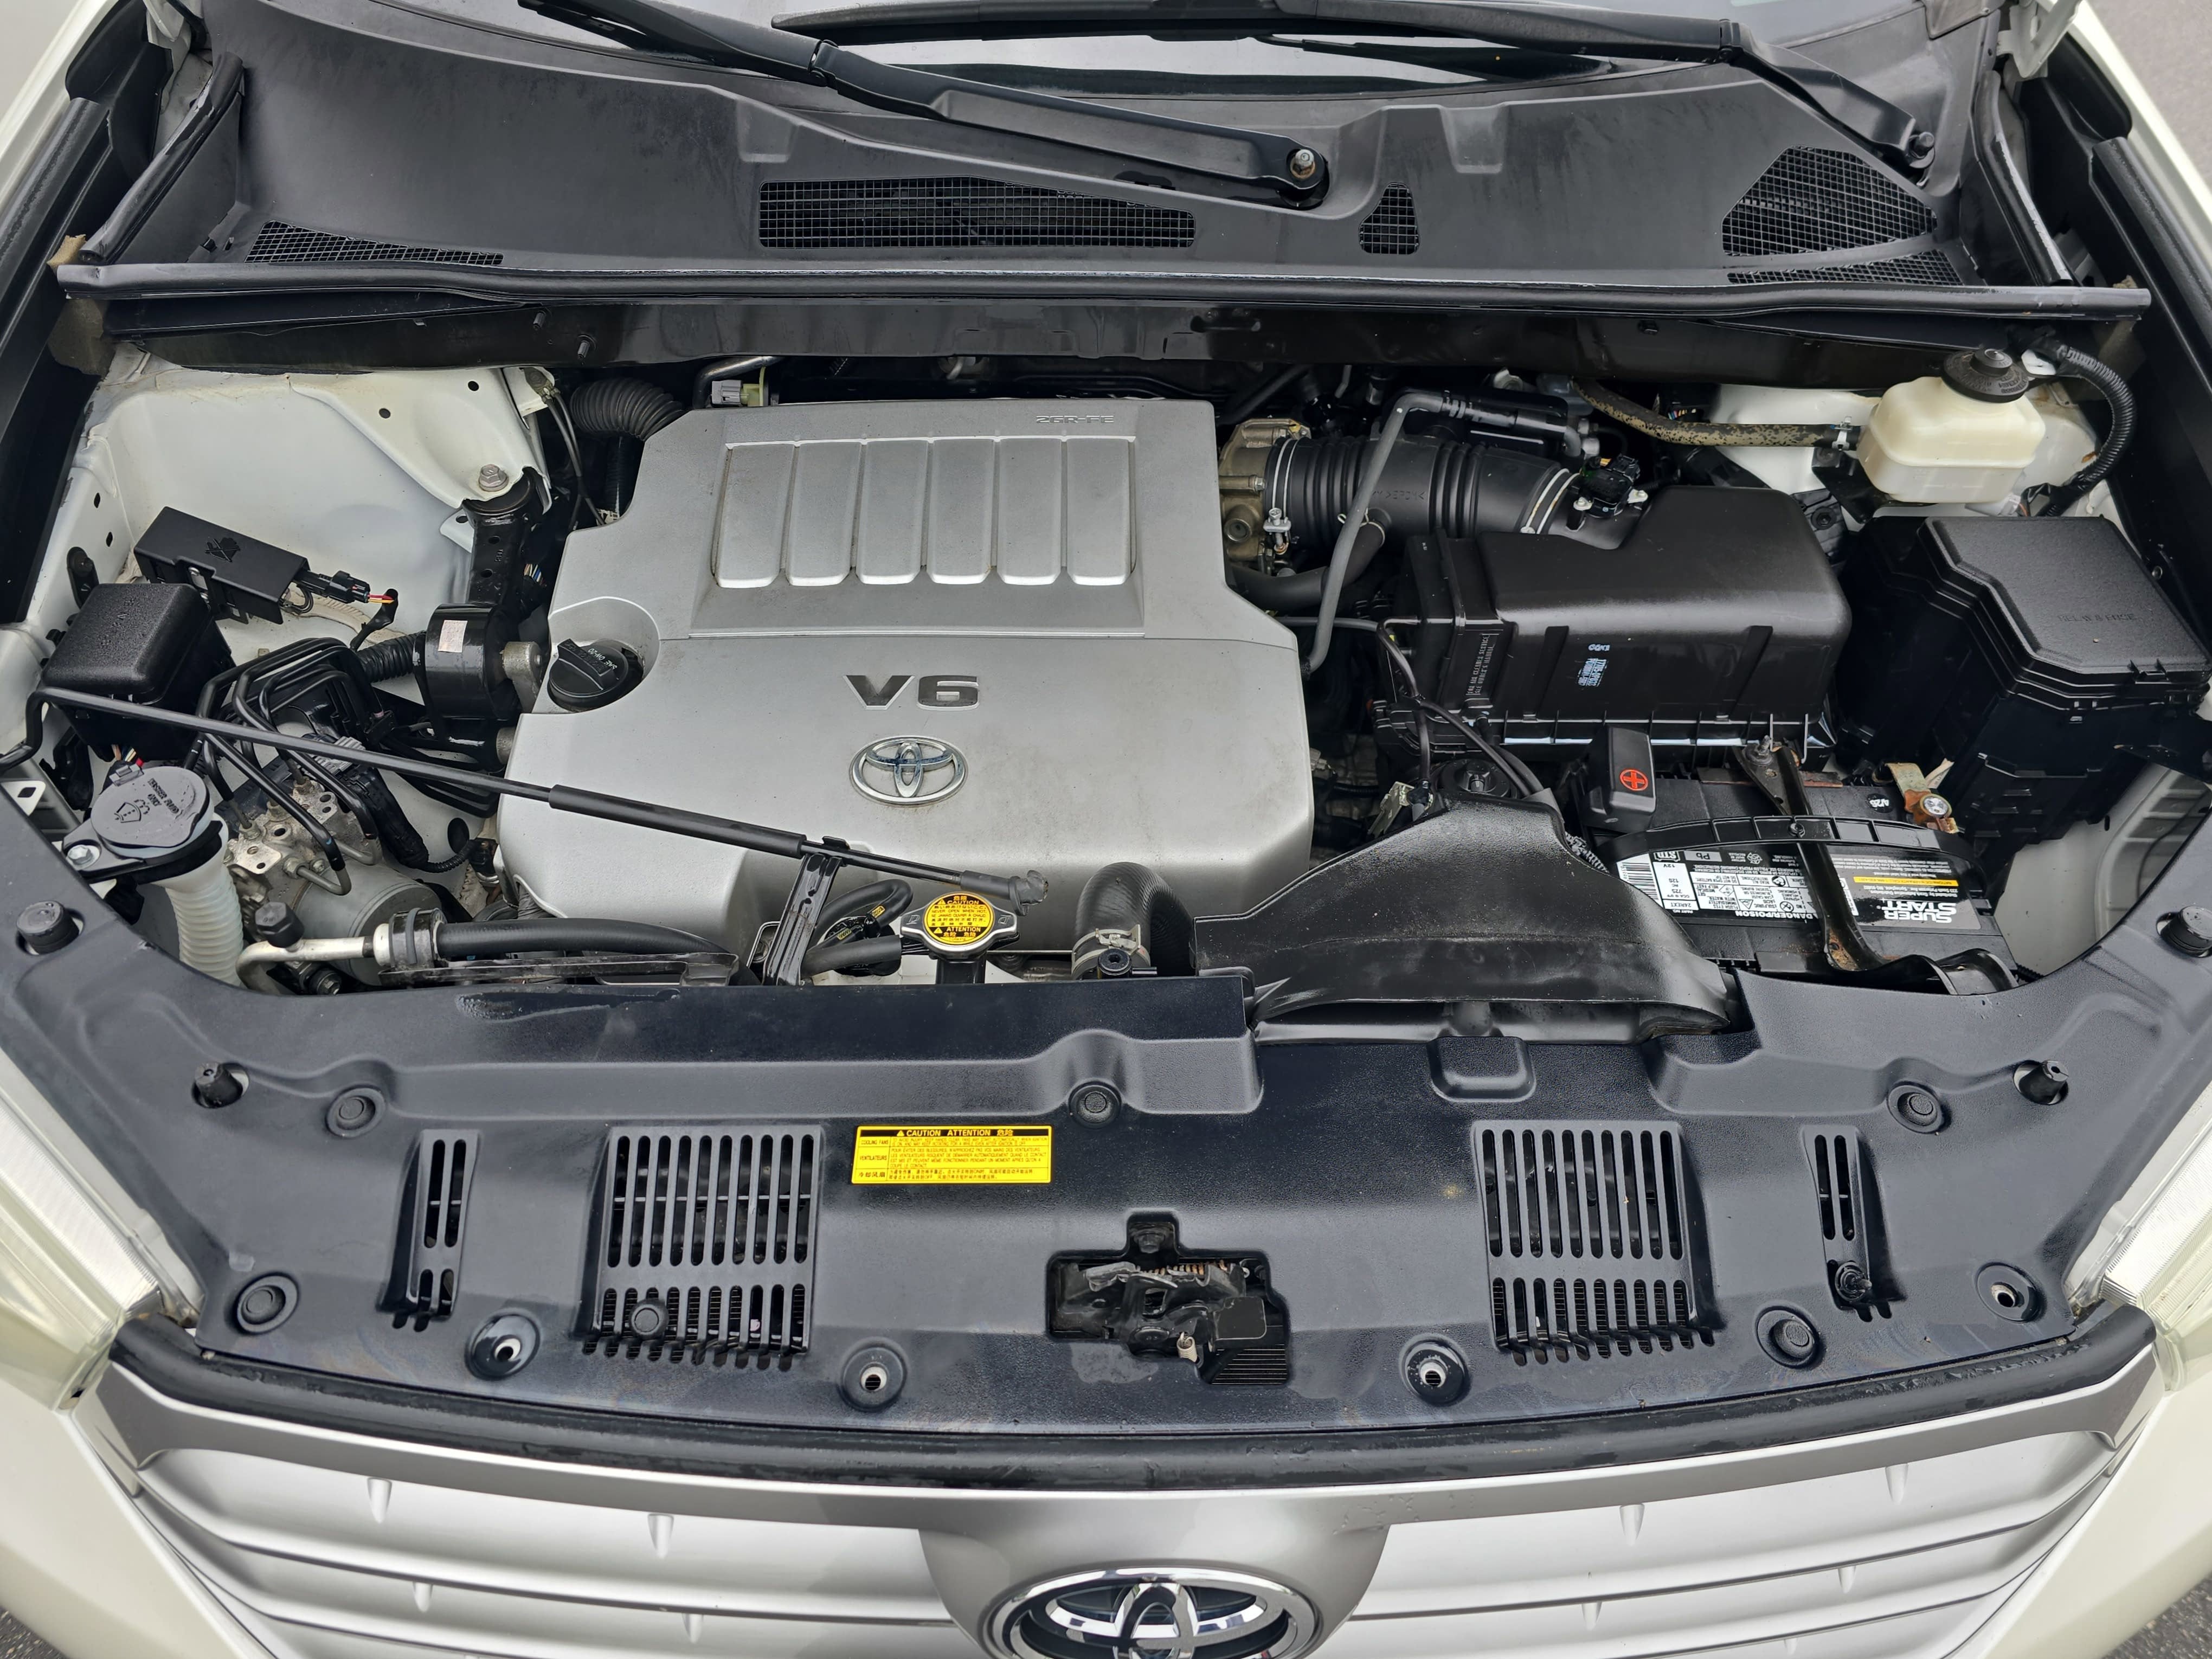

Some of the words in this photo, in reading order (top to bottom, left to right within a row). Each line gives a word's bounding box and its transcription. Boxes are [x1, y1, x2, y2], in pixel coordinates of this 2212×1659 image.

[1036, 415, 1115, 423] 2GR-FE
[603, 660, 618, 670] SAE
[843, 675, 979, 711] V6
[1881, 901, 1957, 915] START
[1735, 911, 1813, 919] DANGER/POISON
[1884, 910, 1953, 923] SUPER
